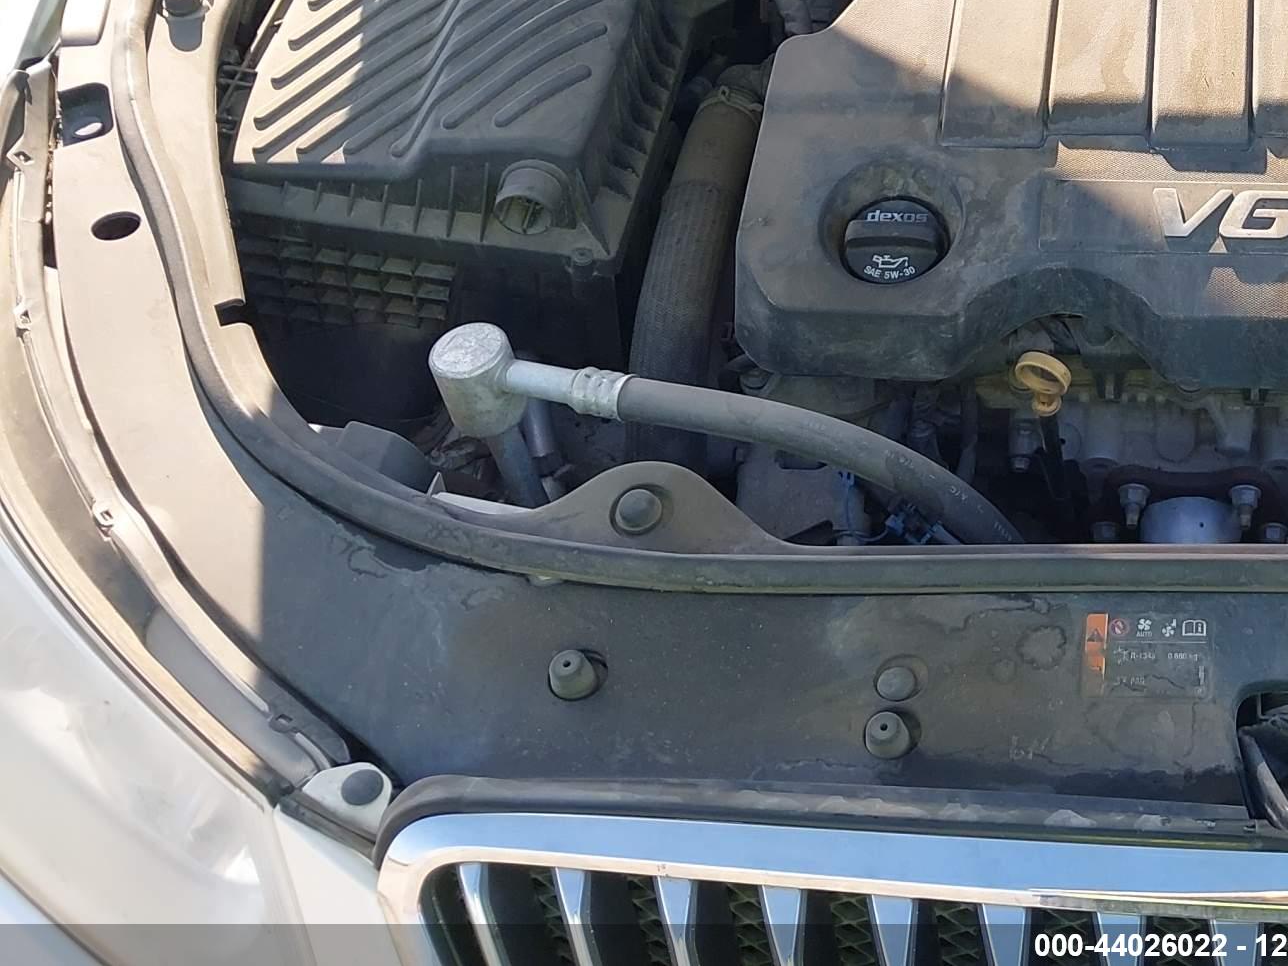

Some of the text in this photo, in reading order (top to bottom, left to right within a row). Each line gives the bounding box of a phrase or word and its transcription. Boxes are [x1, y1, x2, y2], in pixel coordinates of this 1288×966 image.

[864, 210, 929, 223] dexos
[863, 265, 916, 280] SAE 5W-30
